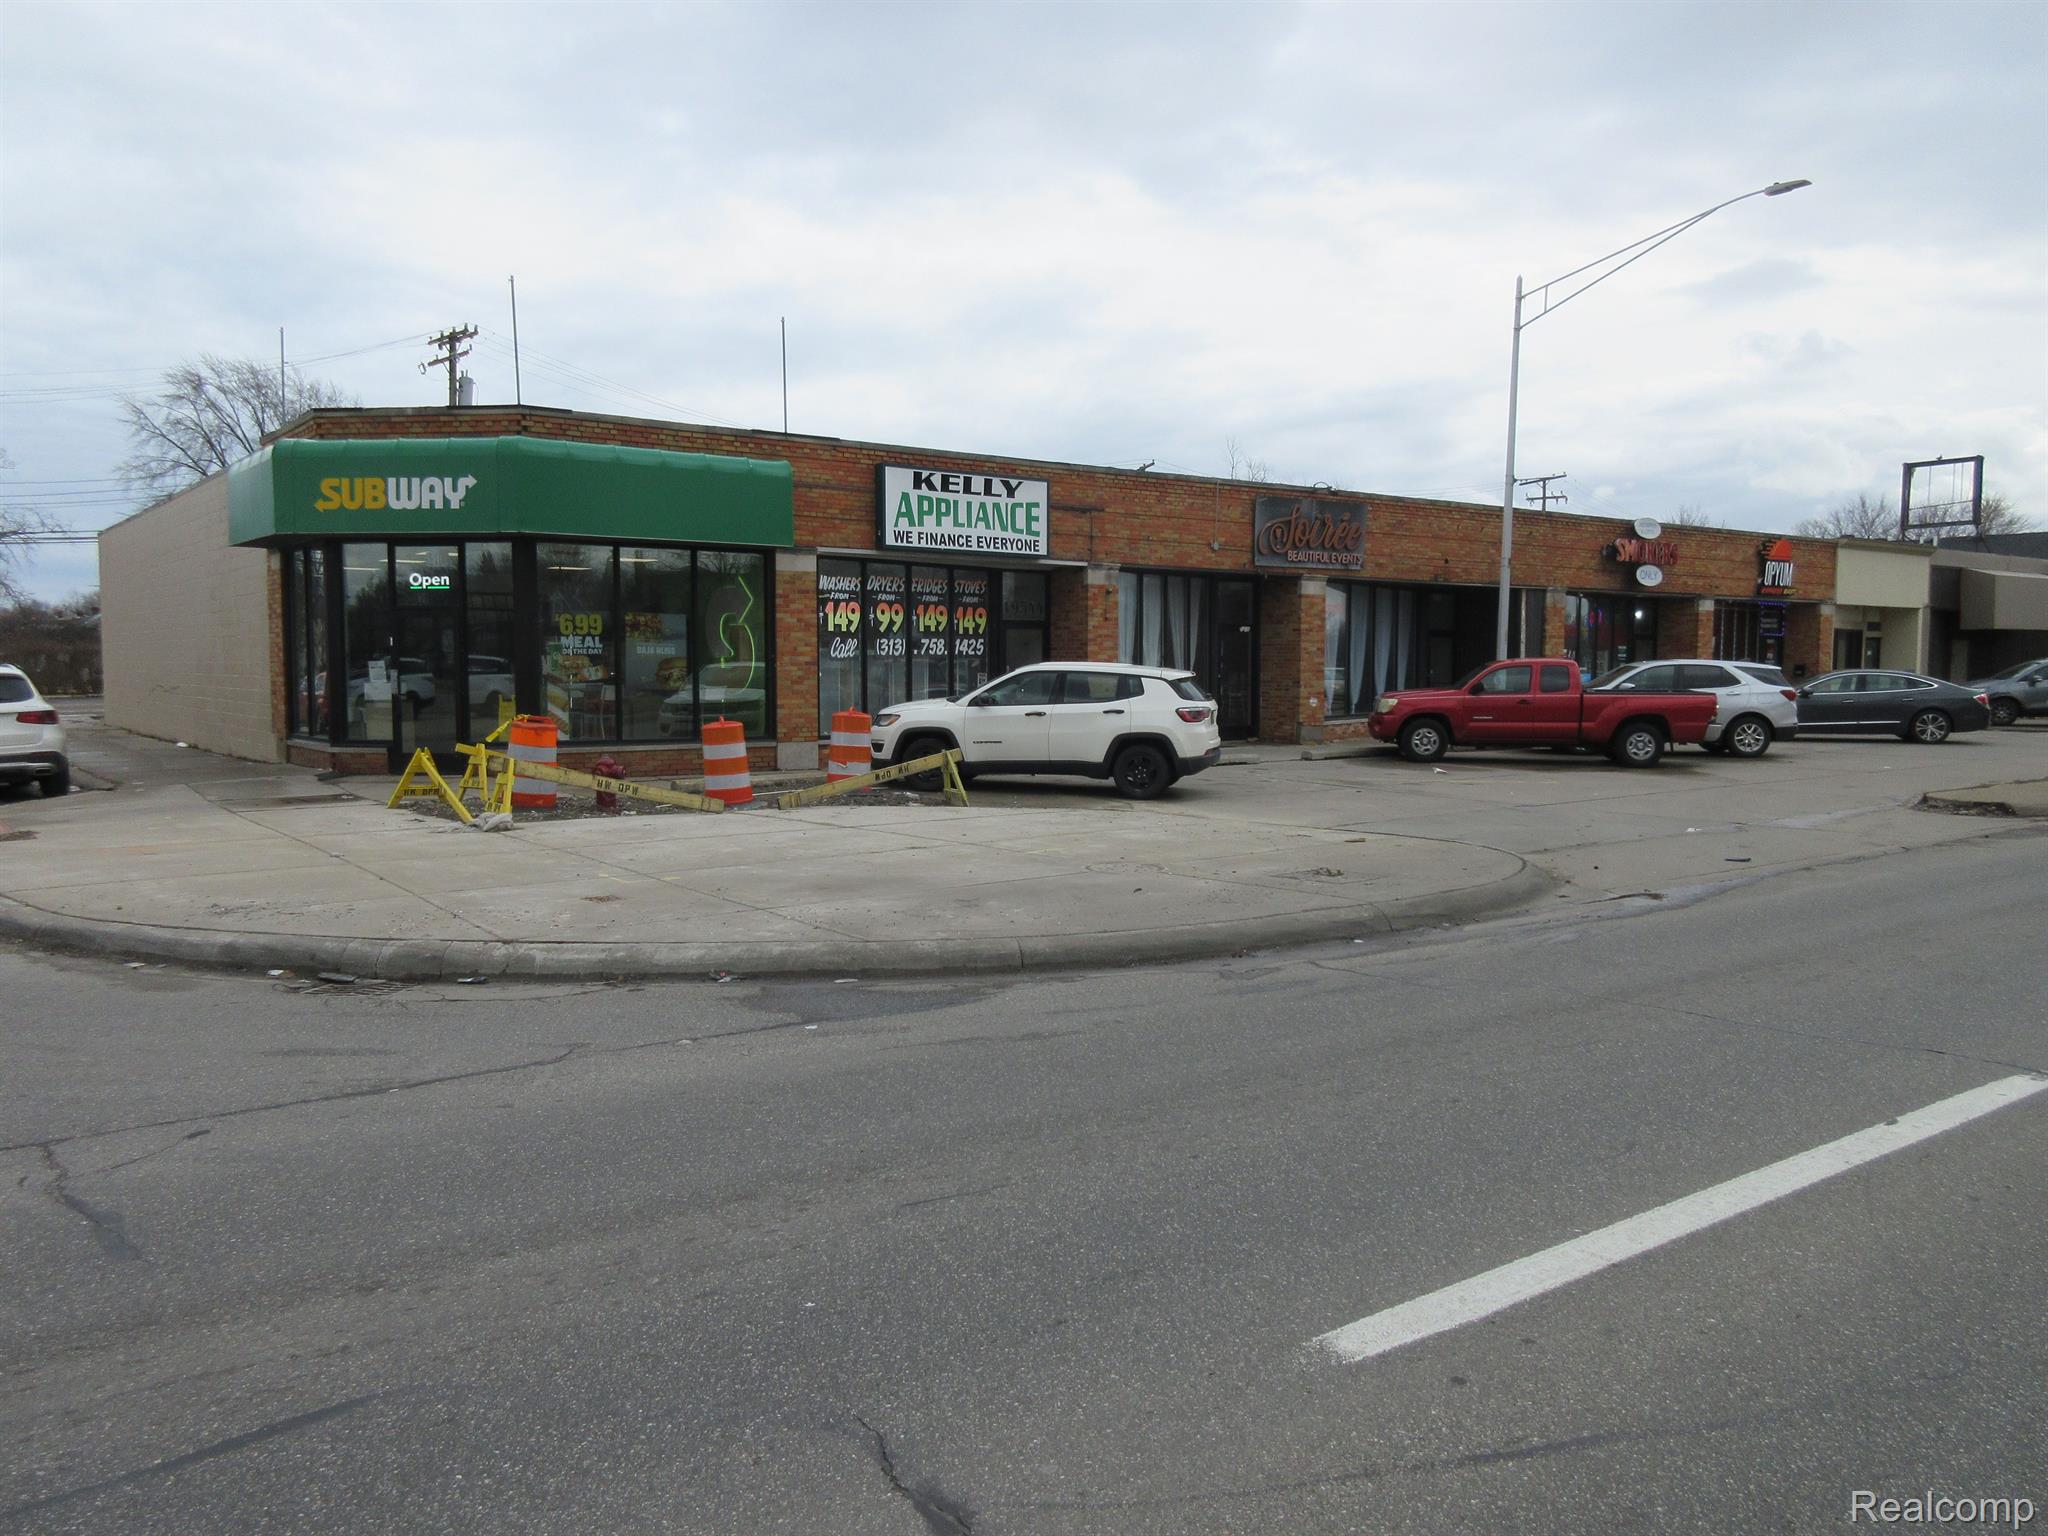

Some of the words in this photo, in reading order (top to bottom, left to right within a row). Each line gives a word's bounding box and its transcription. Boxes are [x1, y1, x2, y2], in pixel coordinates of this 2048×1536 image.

[912, 470, 1024, 499] KELLY
[314, 474, 477, 513] SUBWAY
[893, 491, 1041, 538] APPLIANCE
[893, 529, 914, 545] WE
[917, 531, 973, 549] FINANCE
[976, 535, 1040, 553] EVERYONE
[1287, 549, 1331, 564] BEAUTIFUL
[1331, 552, 1361, 566] EVENTS
[409, 572, 450, 589] Open
[1764, 561, 1793, 587] OPYUM
[818, 574, 861, 592] WASHERS
[867, 575, 905, 592] DRYERS
[911, 578, 949, 595] FRIDGES
[954, 580, 988, 595] STOVES
[830, 592, 850, 600] FROM
[878, 593, 895, 601] FROM
[560, 636, 603, 648] MEAL
[830, 637, 858, 658] Call
[876, 638, 906, 656] (313)
[954, 638, 984, 656] 1425
[596, 779, 612, 790] HW
[617, 783, 640, 796] DPW
